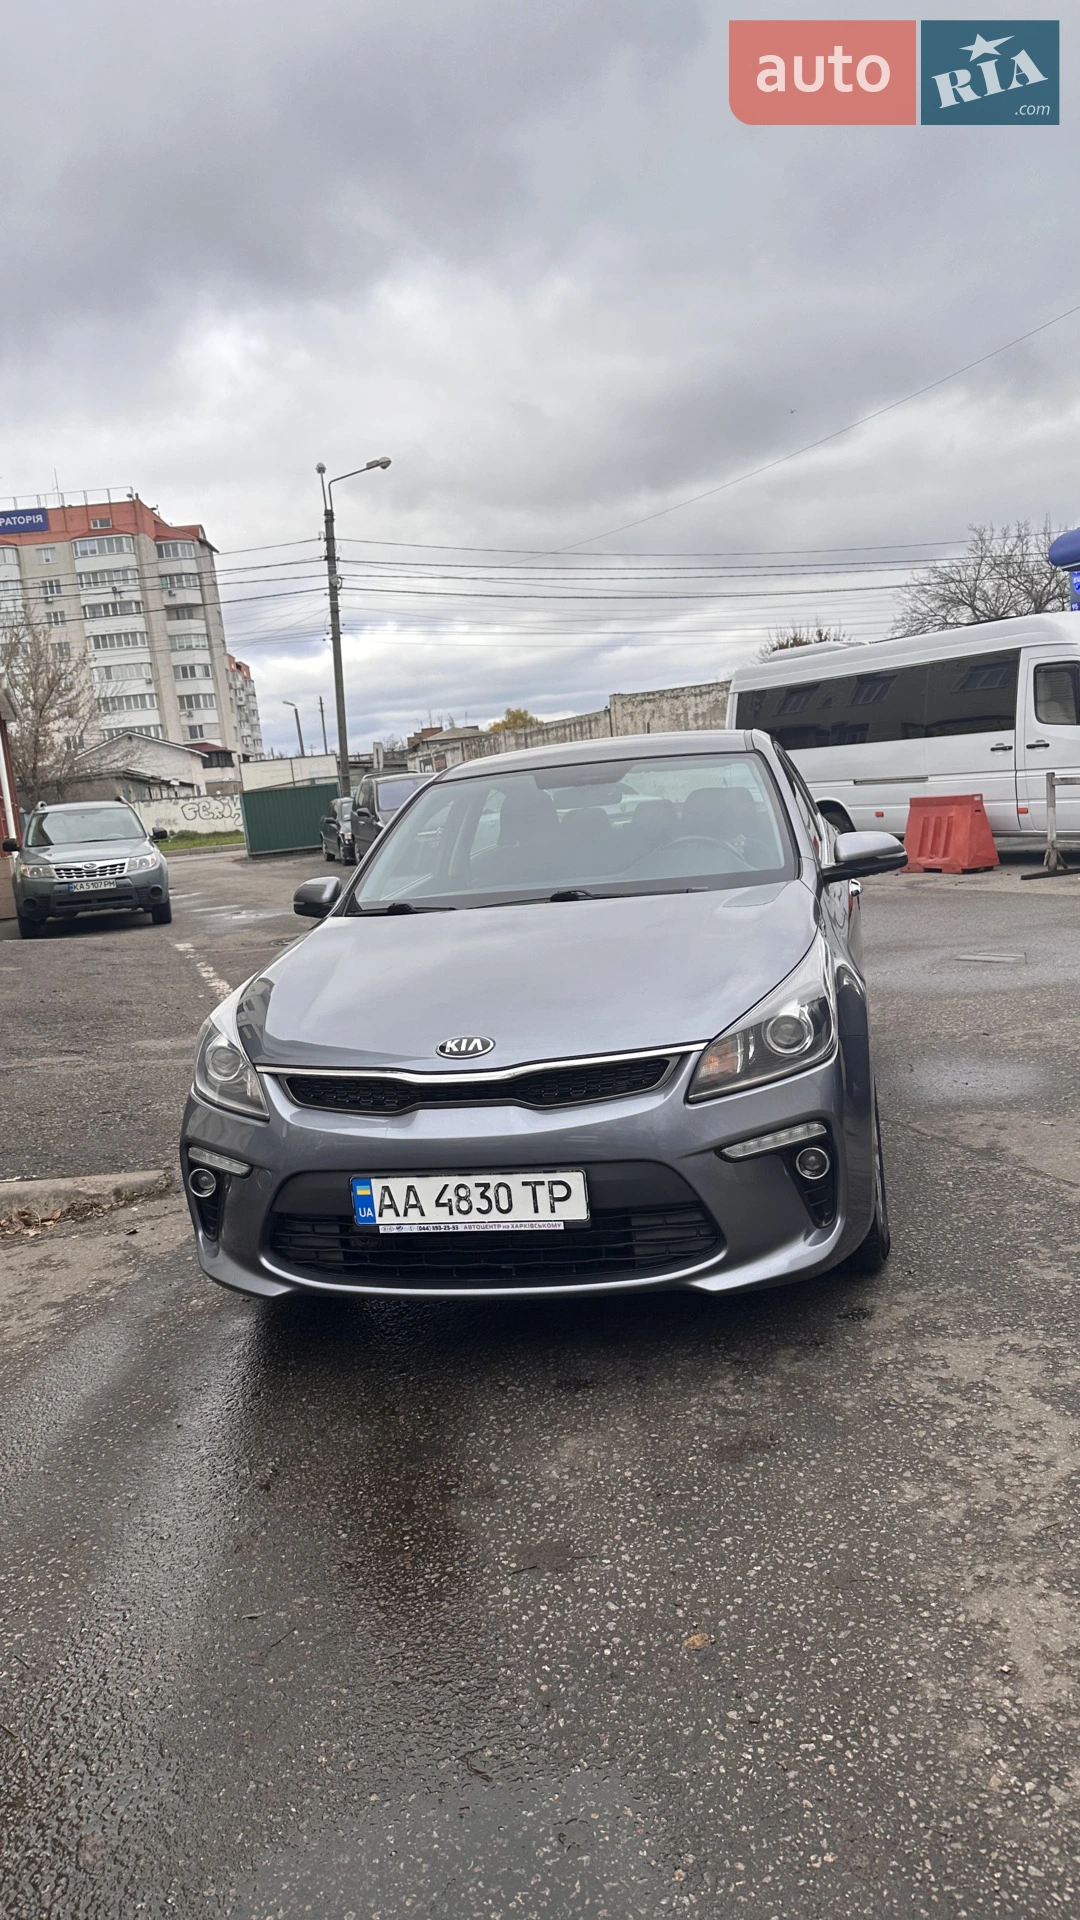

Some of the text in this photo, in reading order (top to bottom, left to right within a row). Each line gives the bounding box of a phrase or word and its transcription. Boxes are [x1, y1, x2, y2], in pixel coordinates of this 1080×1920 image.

[0, 514, 43, 526] РАТОРІЯ
[86, 881, 102, 889] 5107
[445, 1038, 483, 1053] KIA
[378, 1179, 572, 1218] AA 4830 TP
[359, 1207, 374, 1218] UA
